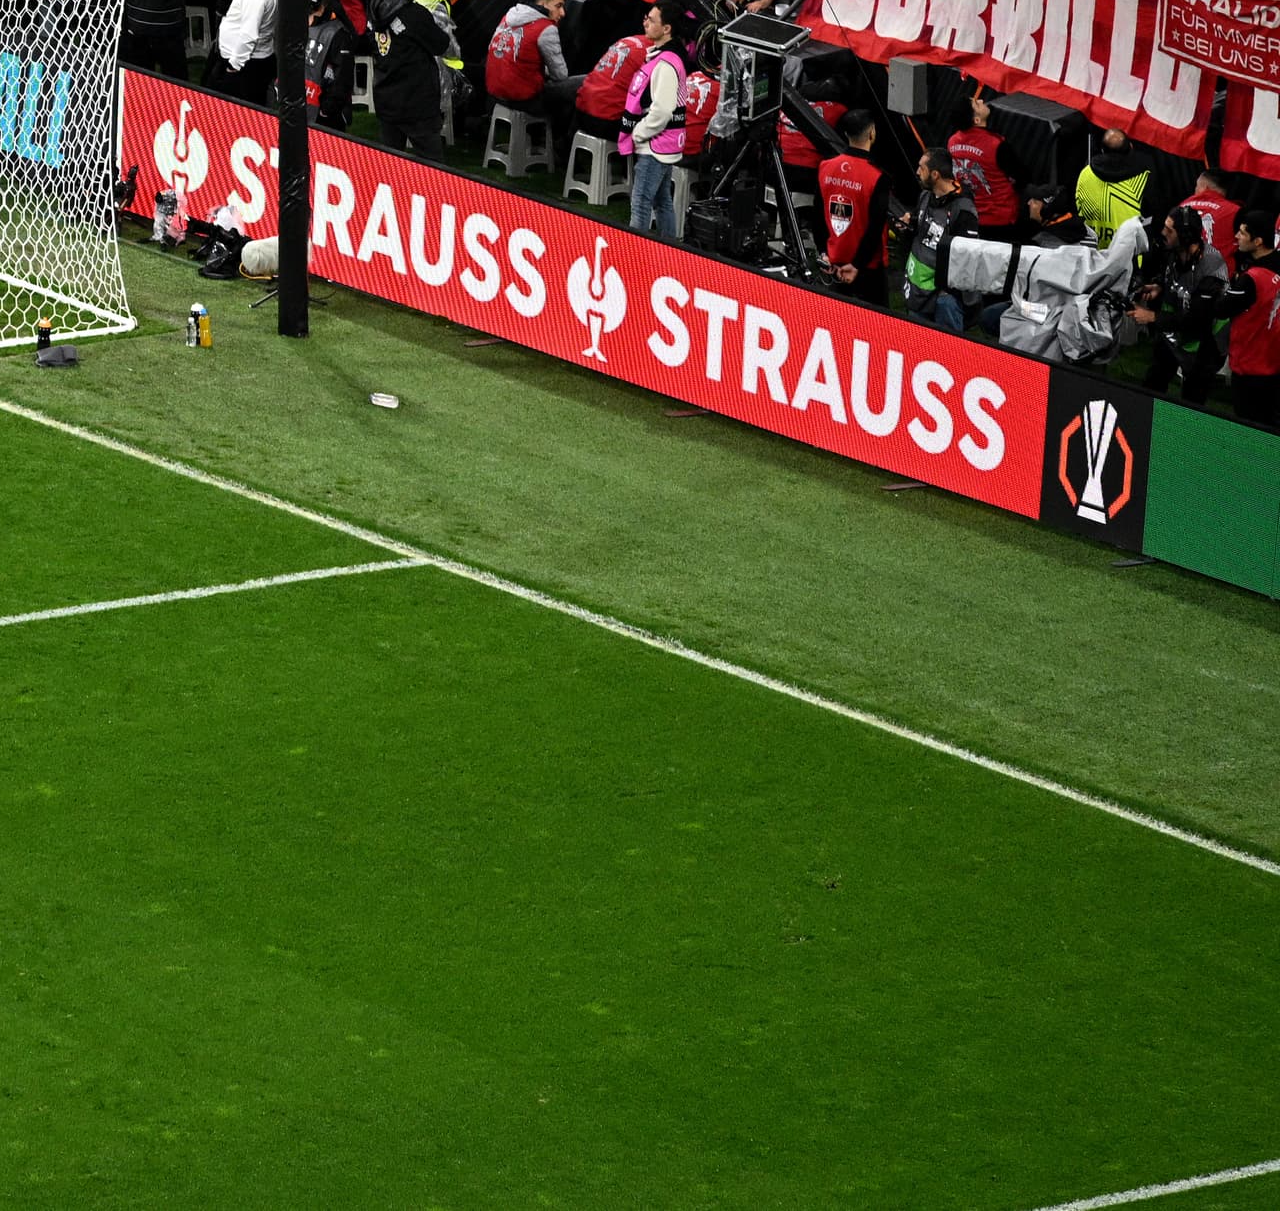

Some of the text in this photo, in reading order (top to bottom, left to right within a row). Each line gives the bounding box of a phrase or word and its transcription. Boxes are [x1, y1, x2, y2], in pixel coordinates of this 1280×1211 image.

[1171, 4, 1208, 34] FÜR
[1184, 33, 1264, 73] BEI UNS
[227, 135, 1007, 471] SRAUSS STRAUSS
